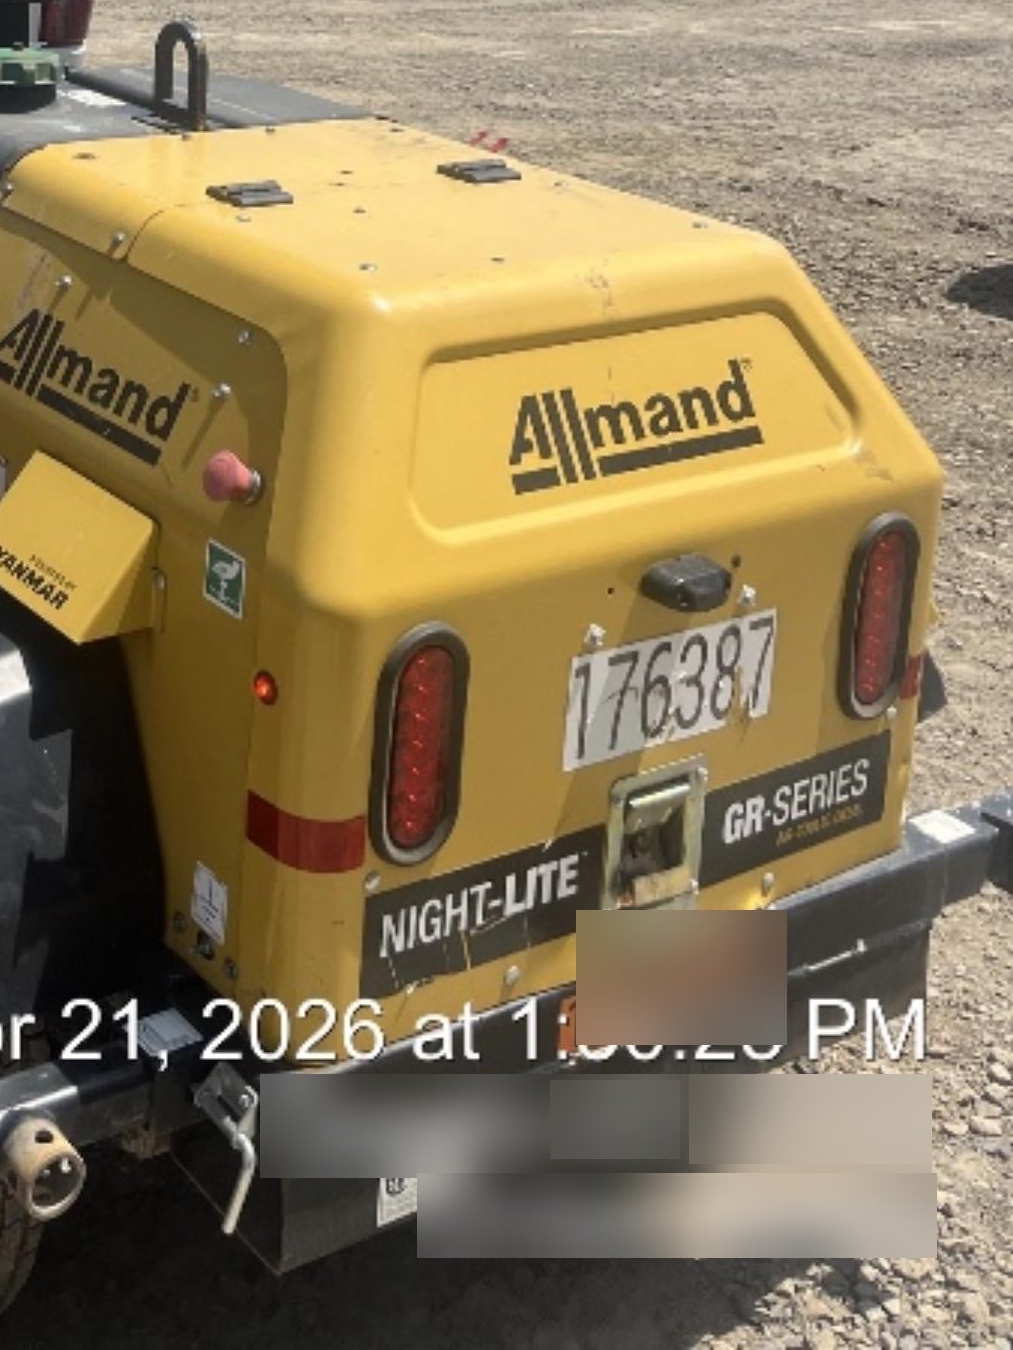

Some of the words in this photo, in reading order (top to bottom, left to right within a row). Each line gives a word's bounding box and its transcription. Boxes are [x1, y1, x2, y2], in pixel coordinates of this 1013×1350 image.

[509, 359, 756, 483] Allmand
[573, 617, 776, 760] 176387
[722, 757, 870, 845] GR-SERIES
[379, 853, 580, 958] NIGHT-LITE
